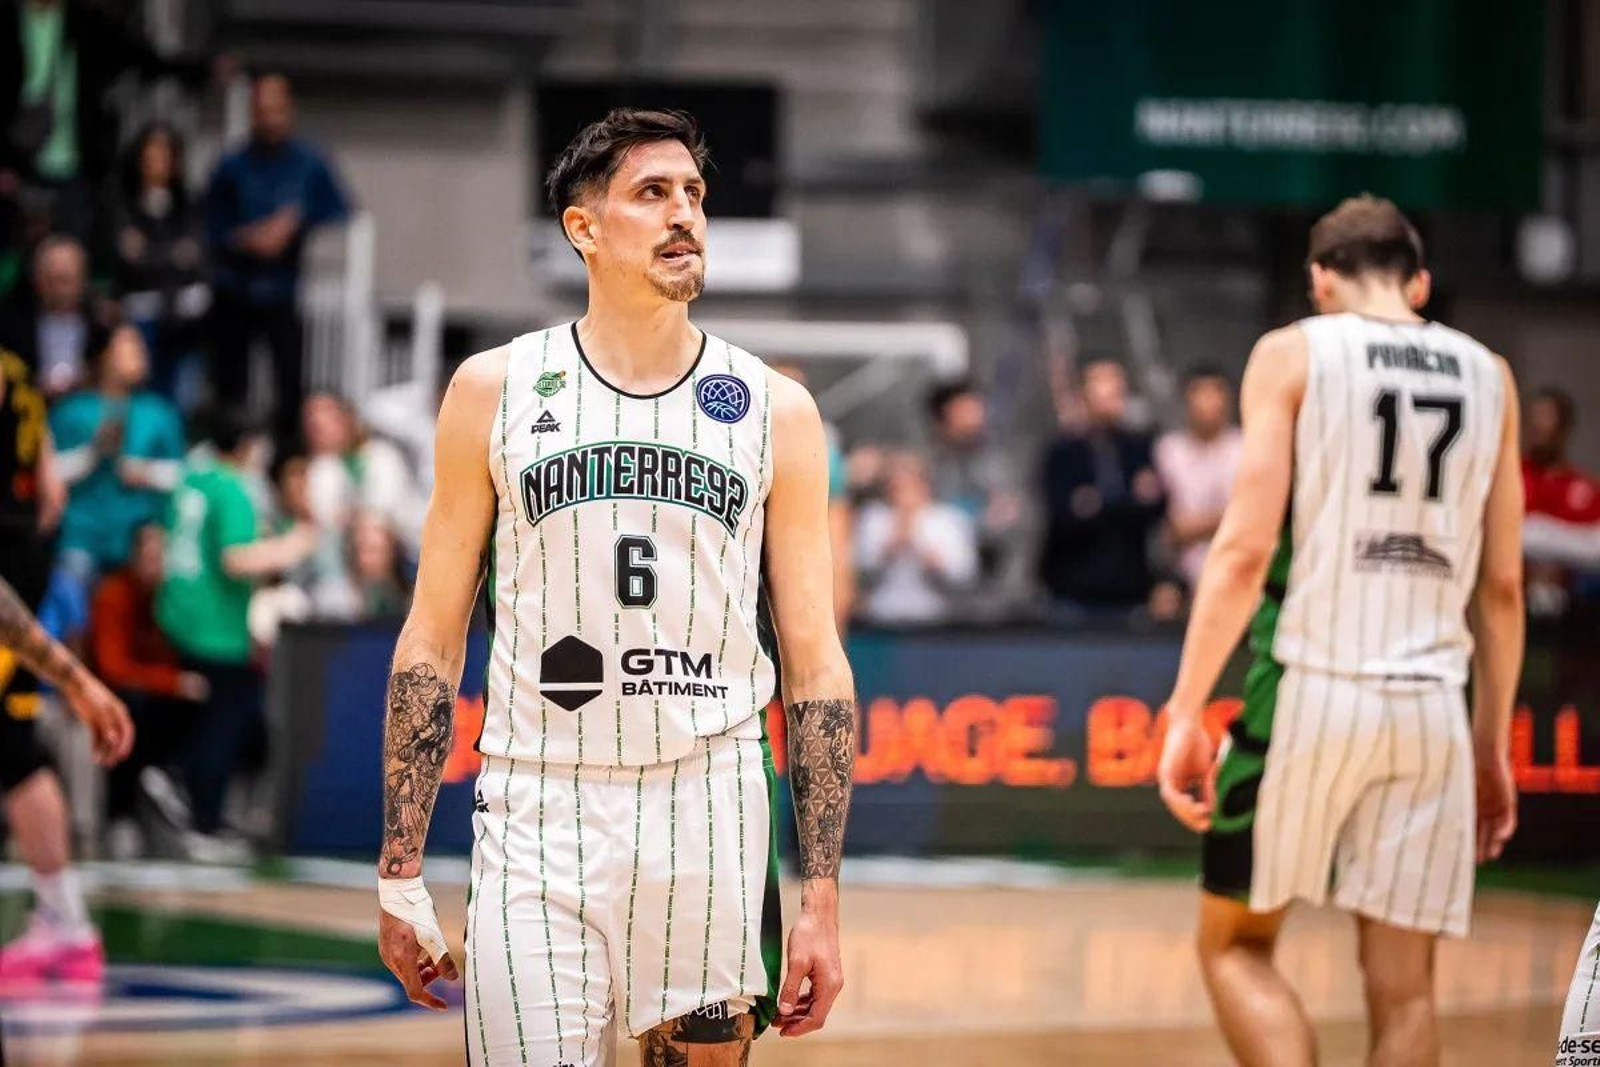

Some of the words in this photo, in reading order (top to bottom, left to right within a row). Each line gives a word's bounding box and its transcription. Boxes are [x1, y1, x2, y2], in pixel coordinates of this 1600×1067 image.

[531, 422, 562, 434] PEAK
[1370, 386, 1467, 502] 17
[520, 441, 748, 538] NANTERRE92
[614, 534, 658, 609] 6
[620, 648, 713, 679] GTM
[621, 682, 729, 700] BÂTIMENT
